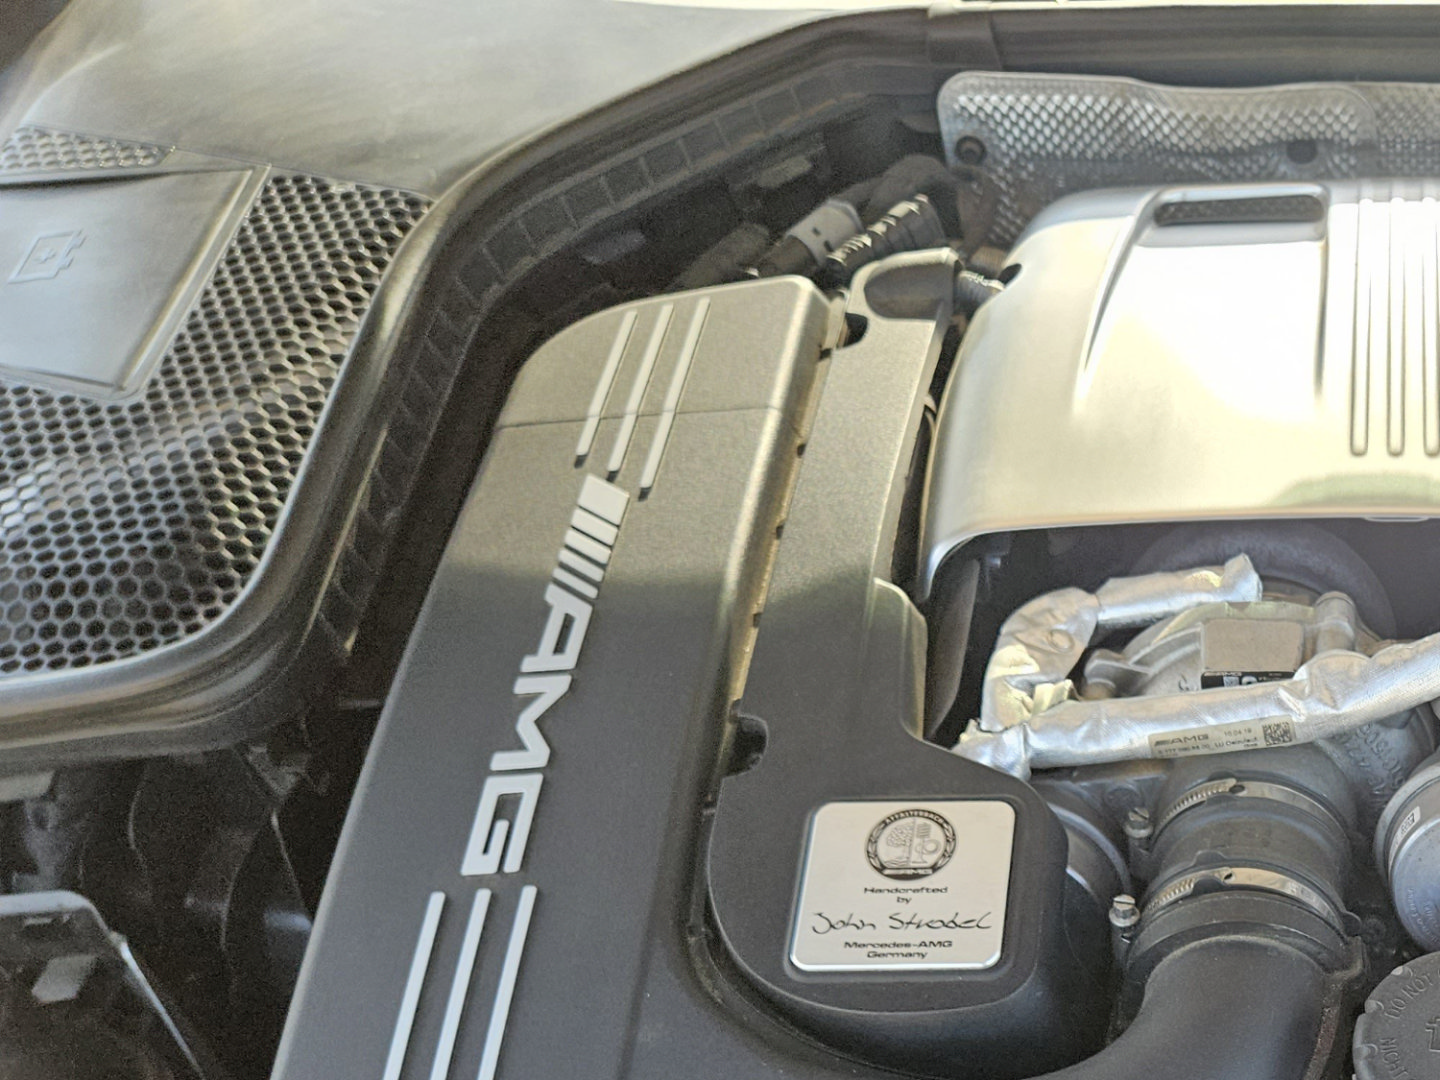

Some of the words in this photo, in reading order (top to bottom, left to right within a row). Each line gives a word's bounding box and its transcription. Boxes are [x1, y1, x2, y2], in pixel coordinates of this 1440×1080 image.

[460, 583, 593, 876] AMG
[864, 886, 948, 894] Handcrafted
[896, 896, 912, 904] by
[812, 912, 876, 934] John
[844, 940, 953, 949] Mercedes-AMG
[867, 950, 928, 959] Germany
